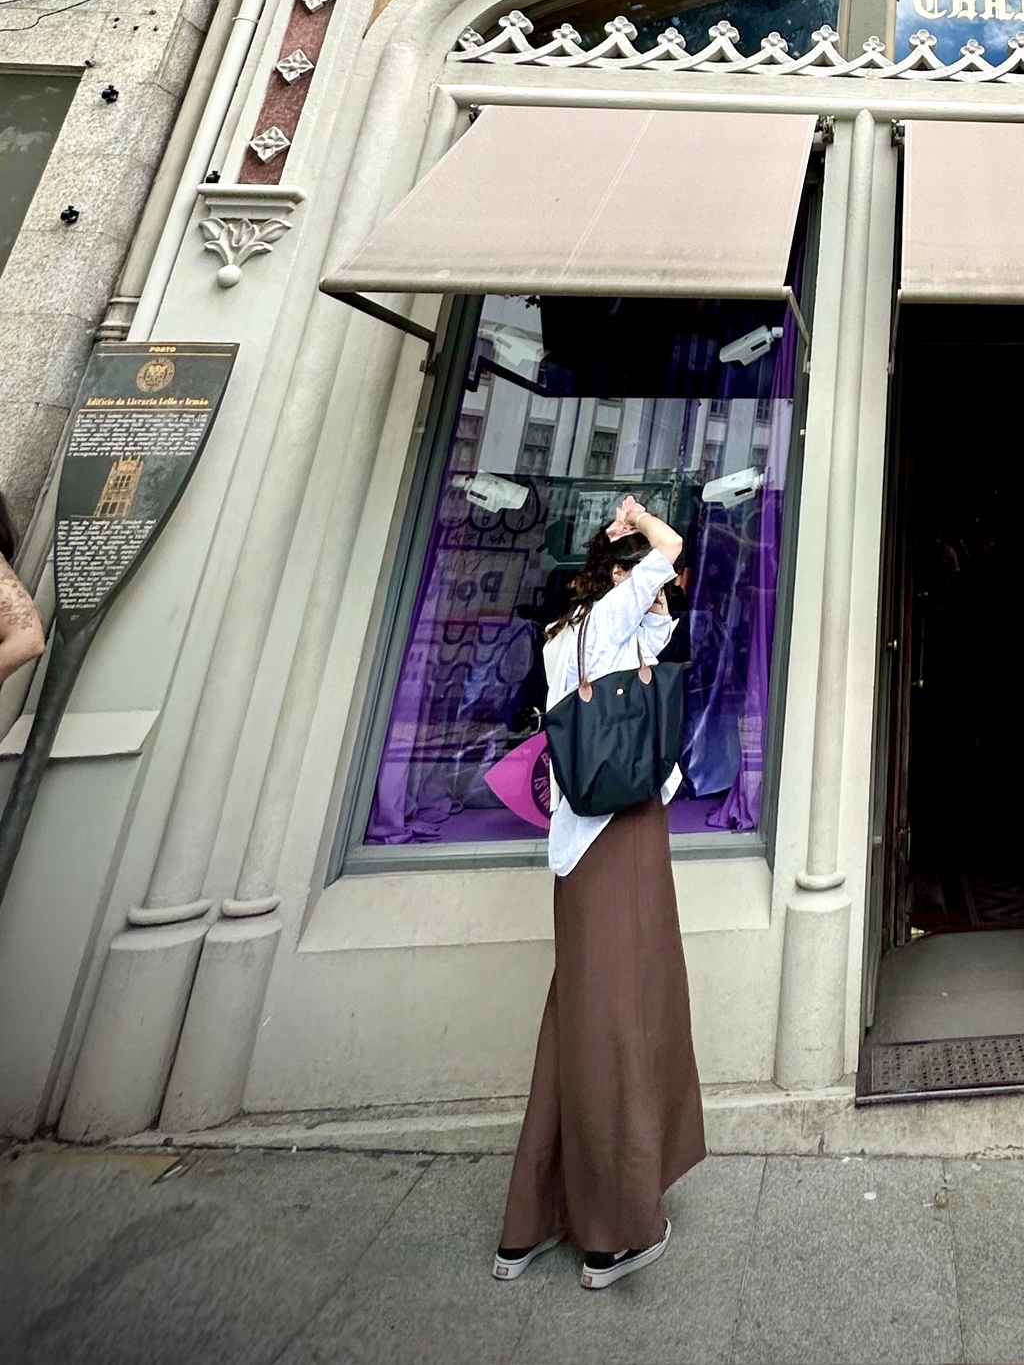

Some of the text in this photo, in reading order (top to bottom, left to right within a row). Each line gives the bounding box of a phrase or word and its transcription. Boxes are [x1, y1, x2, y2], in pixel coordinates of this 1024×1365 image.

[149, 345, 177, 353] PORTO
[116, 397, 125, 406] da
[127, 397, 158, 406] Livraria
[159, 397, 178, 406] Lello
